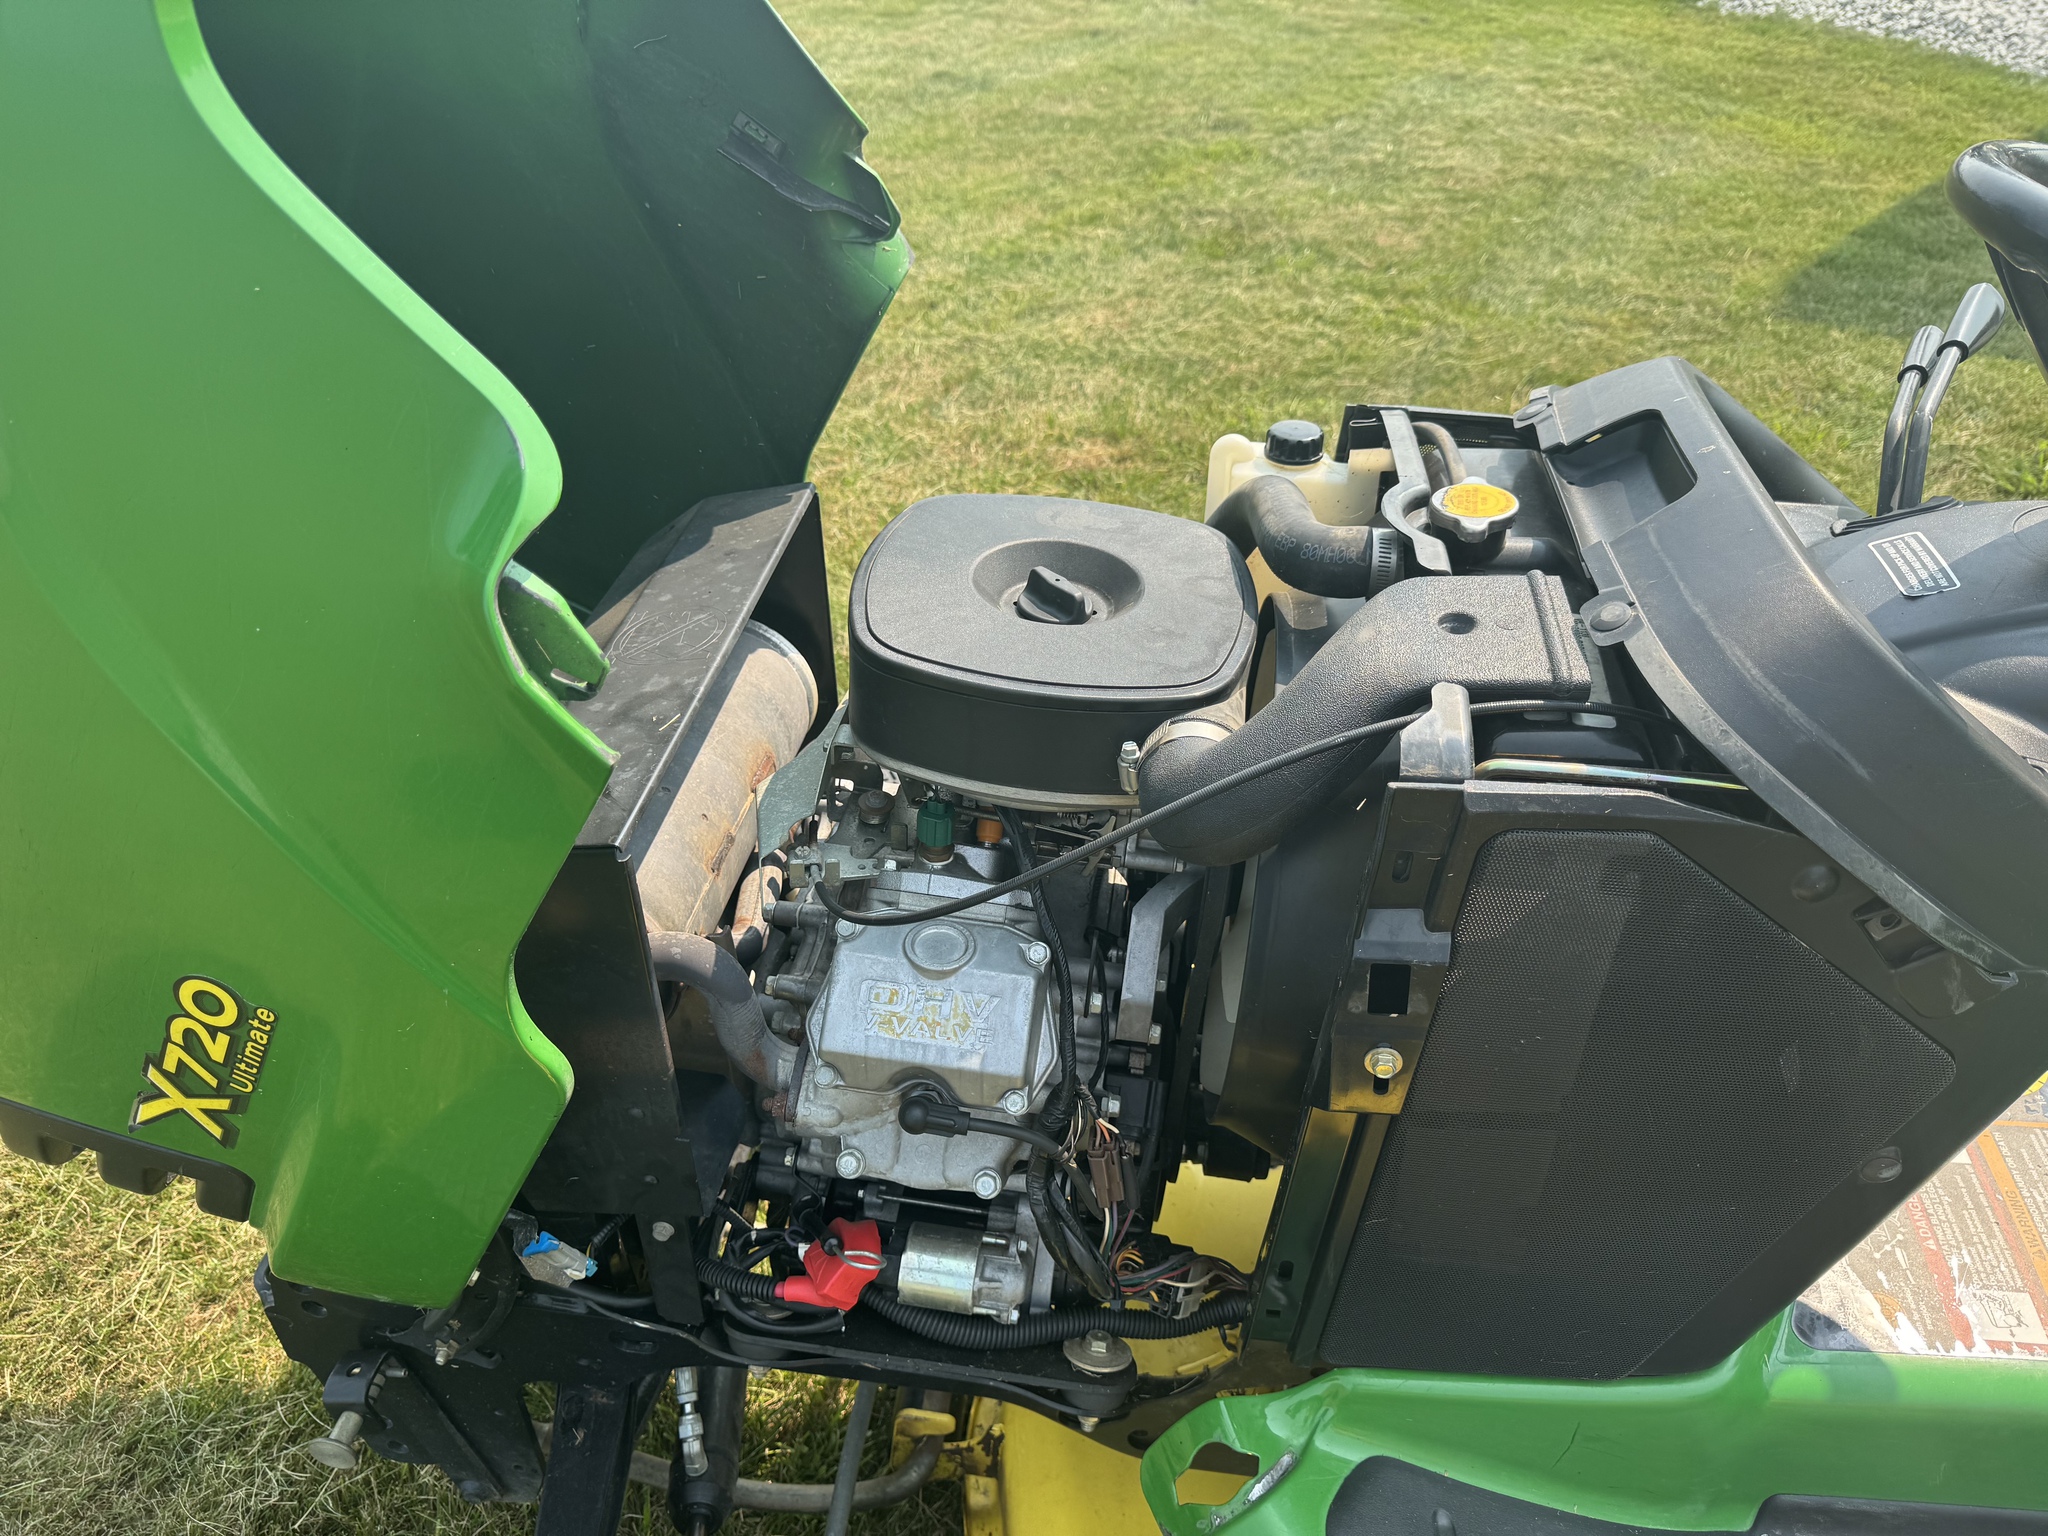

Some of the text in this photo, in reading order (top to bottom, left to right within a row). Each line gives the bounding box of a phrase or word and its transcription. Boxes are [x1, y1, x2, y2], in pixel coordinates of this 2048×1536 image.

[135, 978, 238, 1141] X720
[229, 1006, 276, 1093] Ultimate
[1904, 1194, 1931, 1236] DANGE
[1920, 1193, 1940, 1223] BLADES
[2004, 1190, 2041, 1248] WARNING
[2024, 1198, 2048, 1232] SERIOUS
